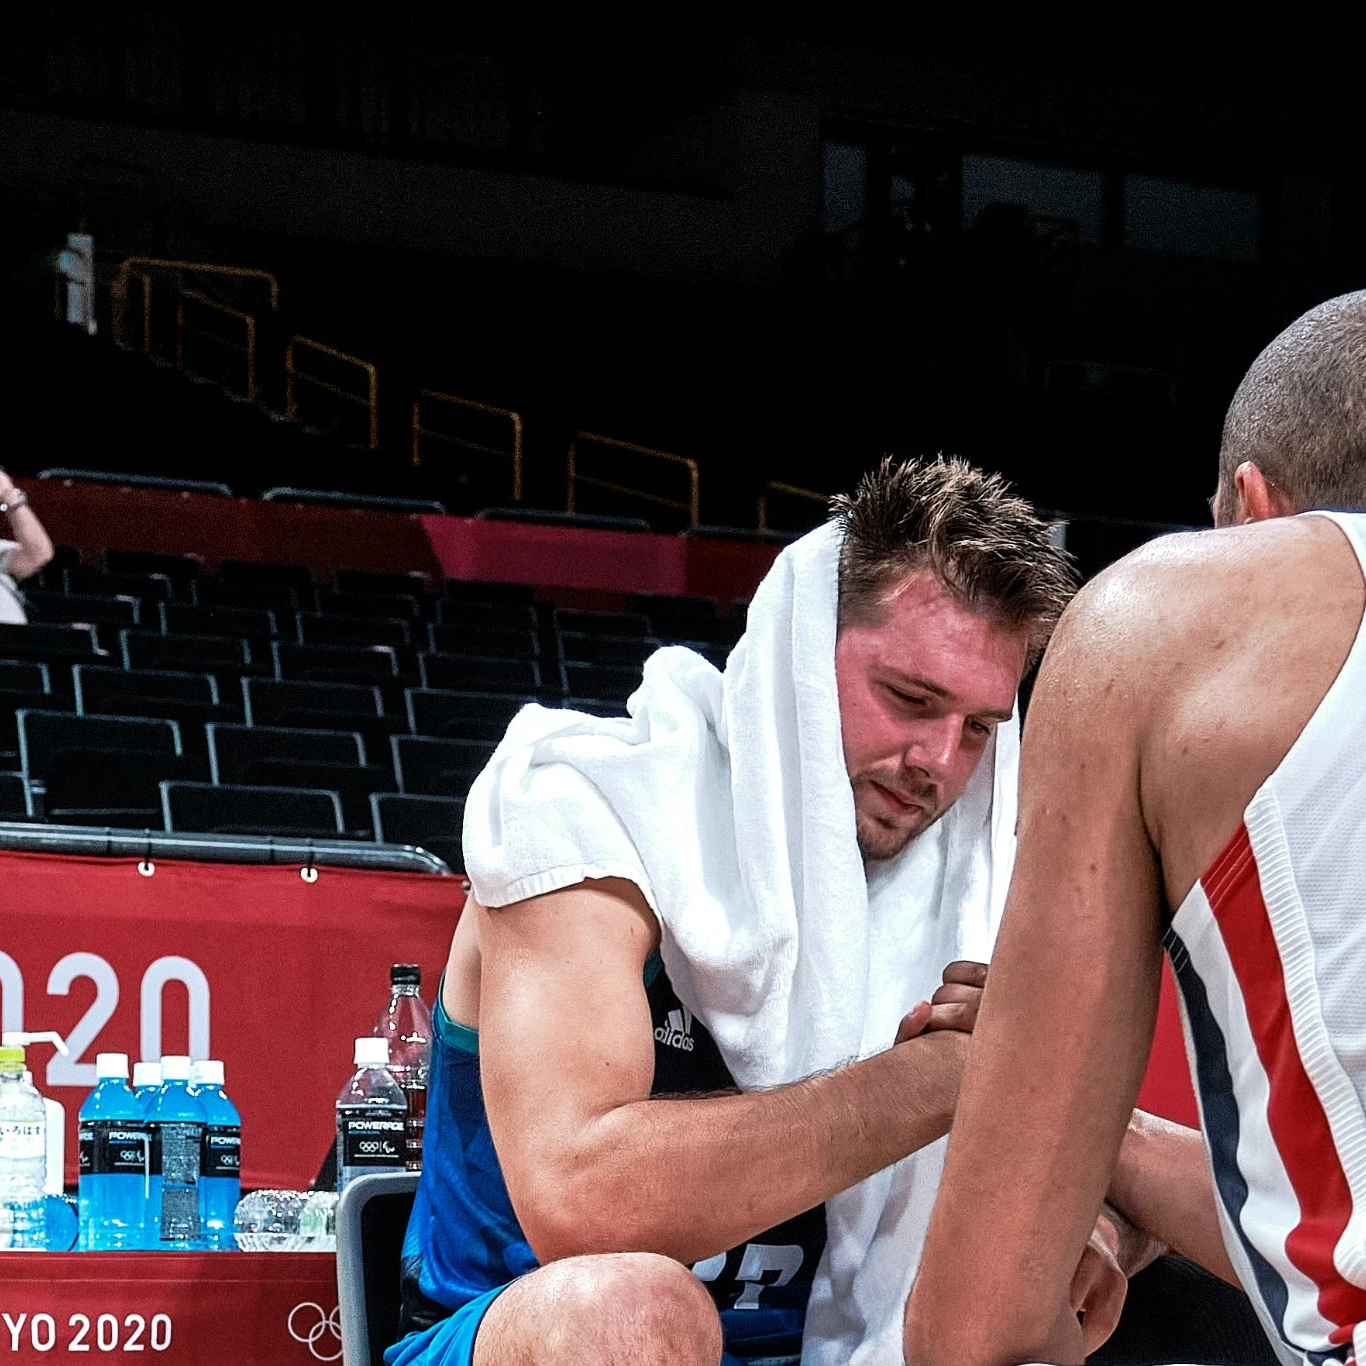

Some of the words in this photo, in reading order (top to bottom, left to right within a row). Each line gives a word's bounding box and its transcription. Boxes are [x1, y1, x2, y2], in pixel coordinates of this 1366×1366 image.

[654, 1026, 695, 1052] adidas
[0, 1125, 41, 1136] いろはす
[68, 1312, 172, 1353] 2020
